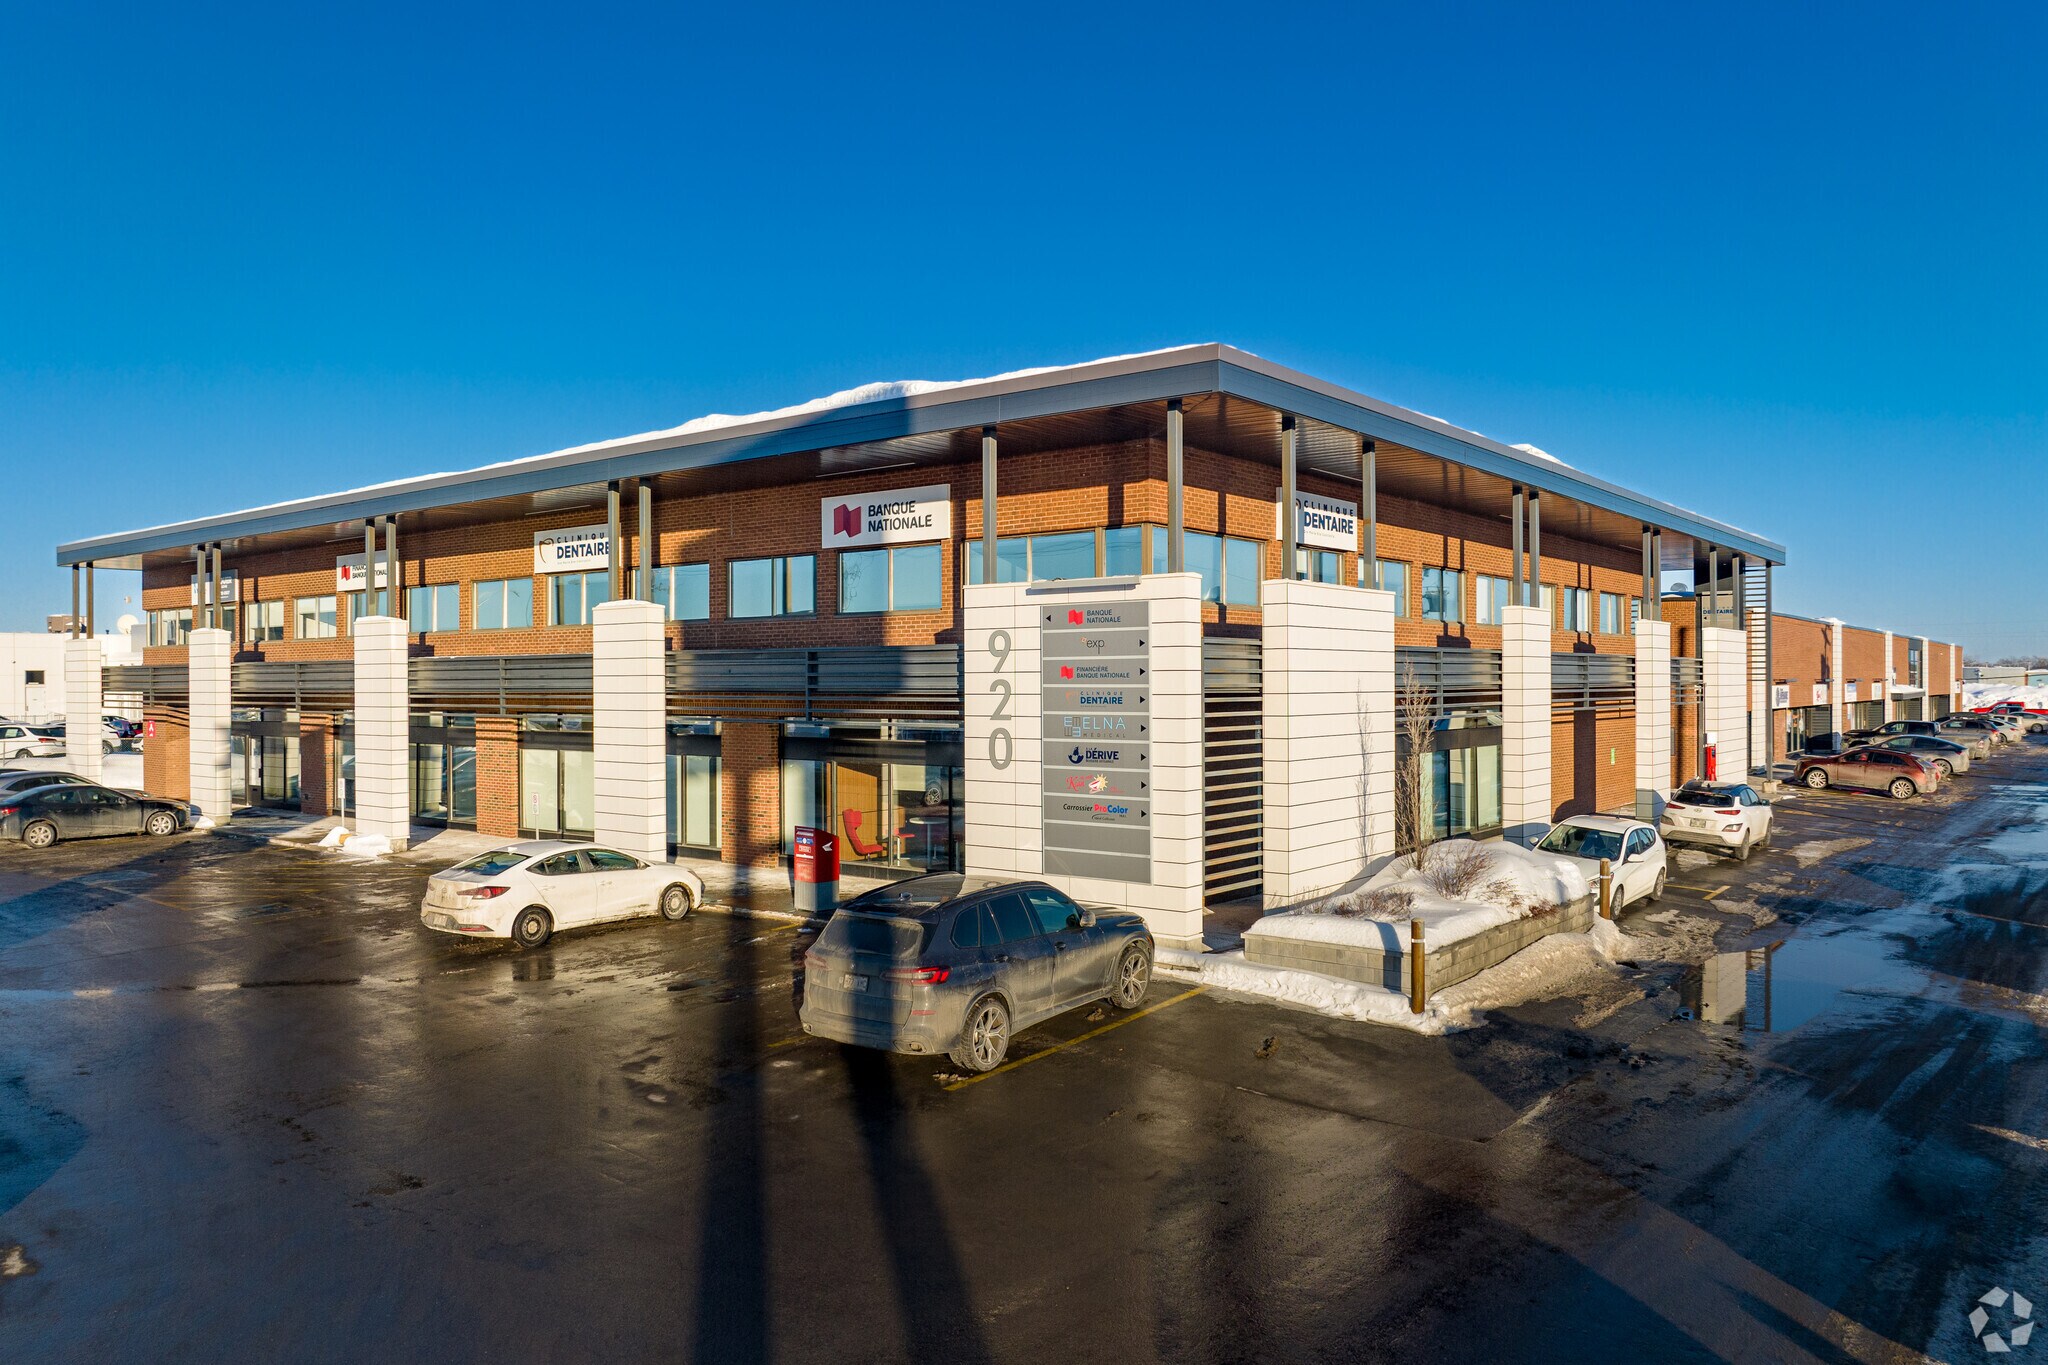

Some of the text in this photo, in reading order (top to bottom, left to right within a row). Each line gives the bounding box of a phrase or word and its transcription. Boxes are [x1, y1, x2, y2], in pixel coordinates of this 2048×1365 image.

[868, 500, 916, 517] BANQUE
[1304, 500, 1354, 517] CLINIQUE
[868, 514, 933, 532] NATIONALE
[1304, 511, 1354, 534] DENTAIRE
[556, 532, 605, 543] CLINIQU
[1086, 640, 1105, 655] exp
[988, 630, 1013, 770] 920
[1080, 696, 1123, 704] DENTAIRE
[1082, 716, 1126, 730] ELNA
[1085, 747, 1119, 760] DÉRIVE
[1063, 803, 1128, 813] Carrossier ProColor
